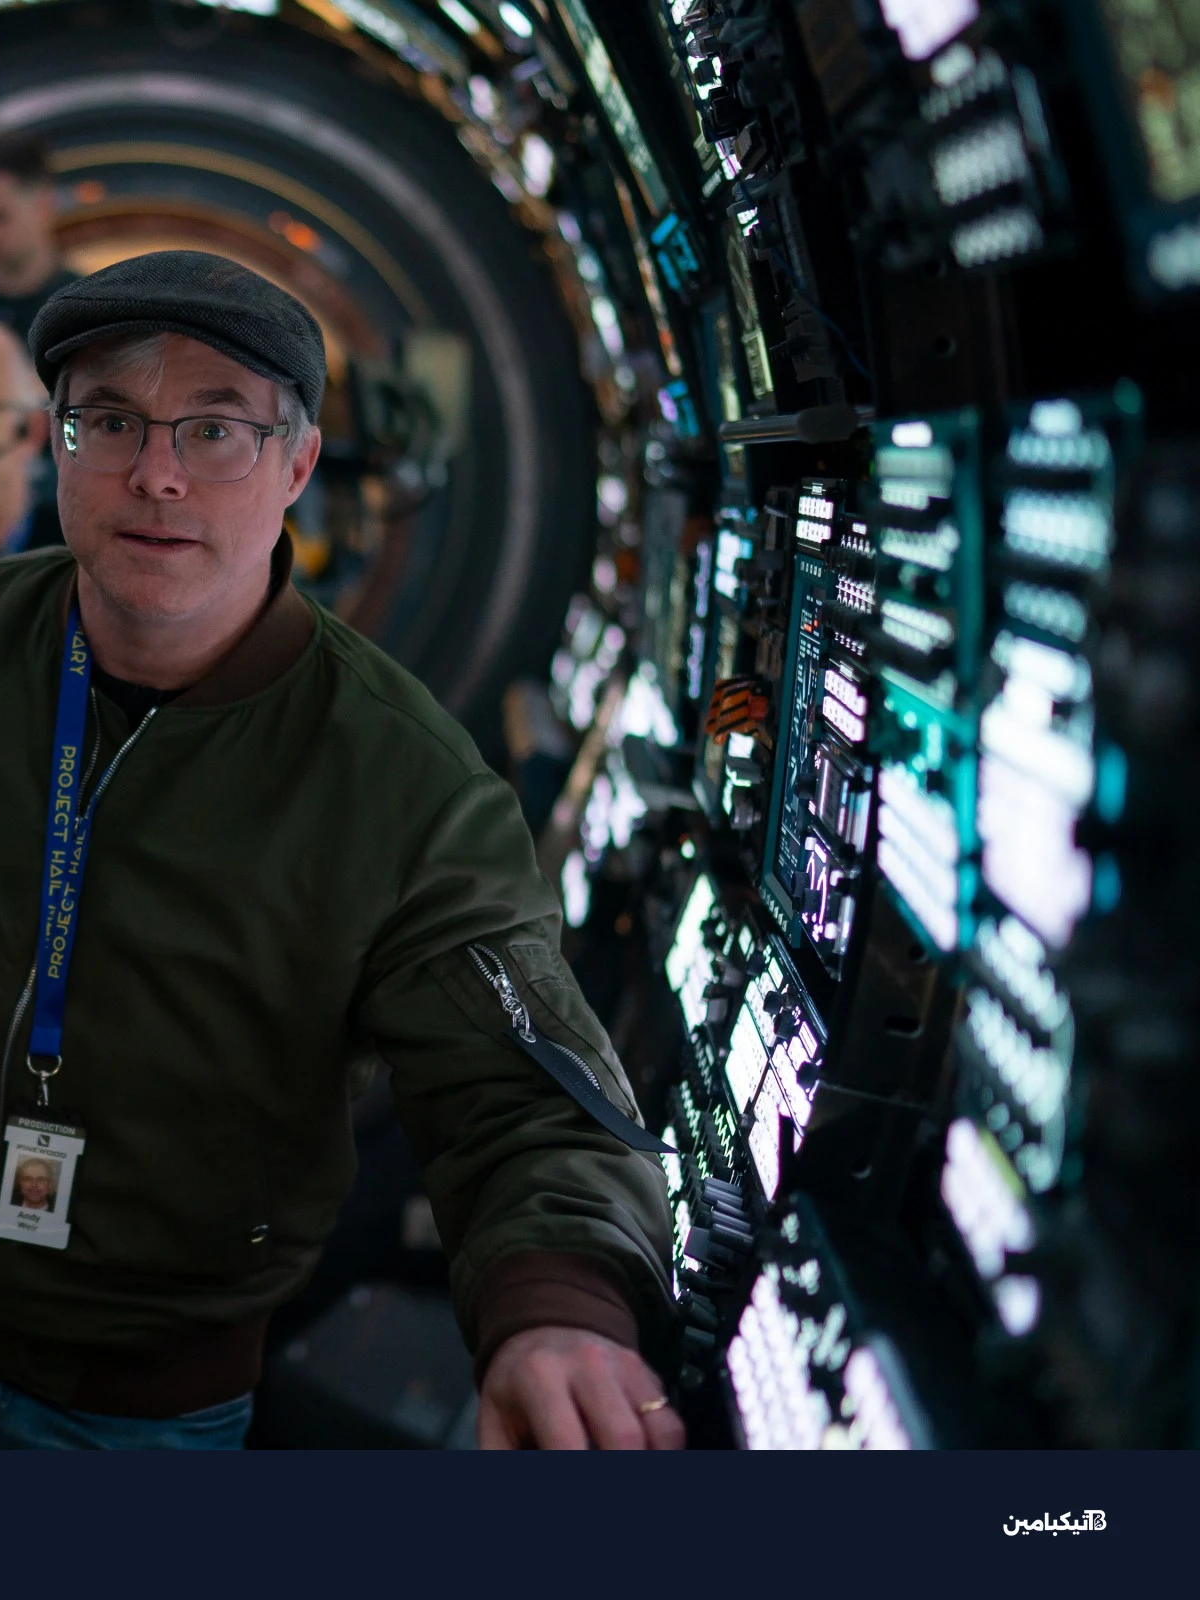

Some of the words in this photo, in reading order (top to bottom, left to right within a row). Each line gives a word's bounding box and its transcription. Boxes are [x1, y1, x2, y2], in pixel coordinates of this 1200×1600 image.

[69, 631, 87, 676] ARY
[53, 745, 77, 842] PROJECT
[48, 850, 66, 896] HAIL
[47, 882, 76, 978] PROJECT
[67, 828, 87, 874] HAIL
[18, 1117, 76, 1135] PRODUCTION
